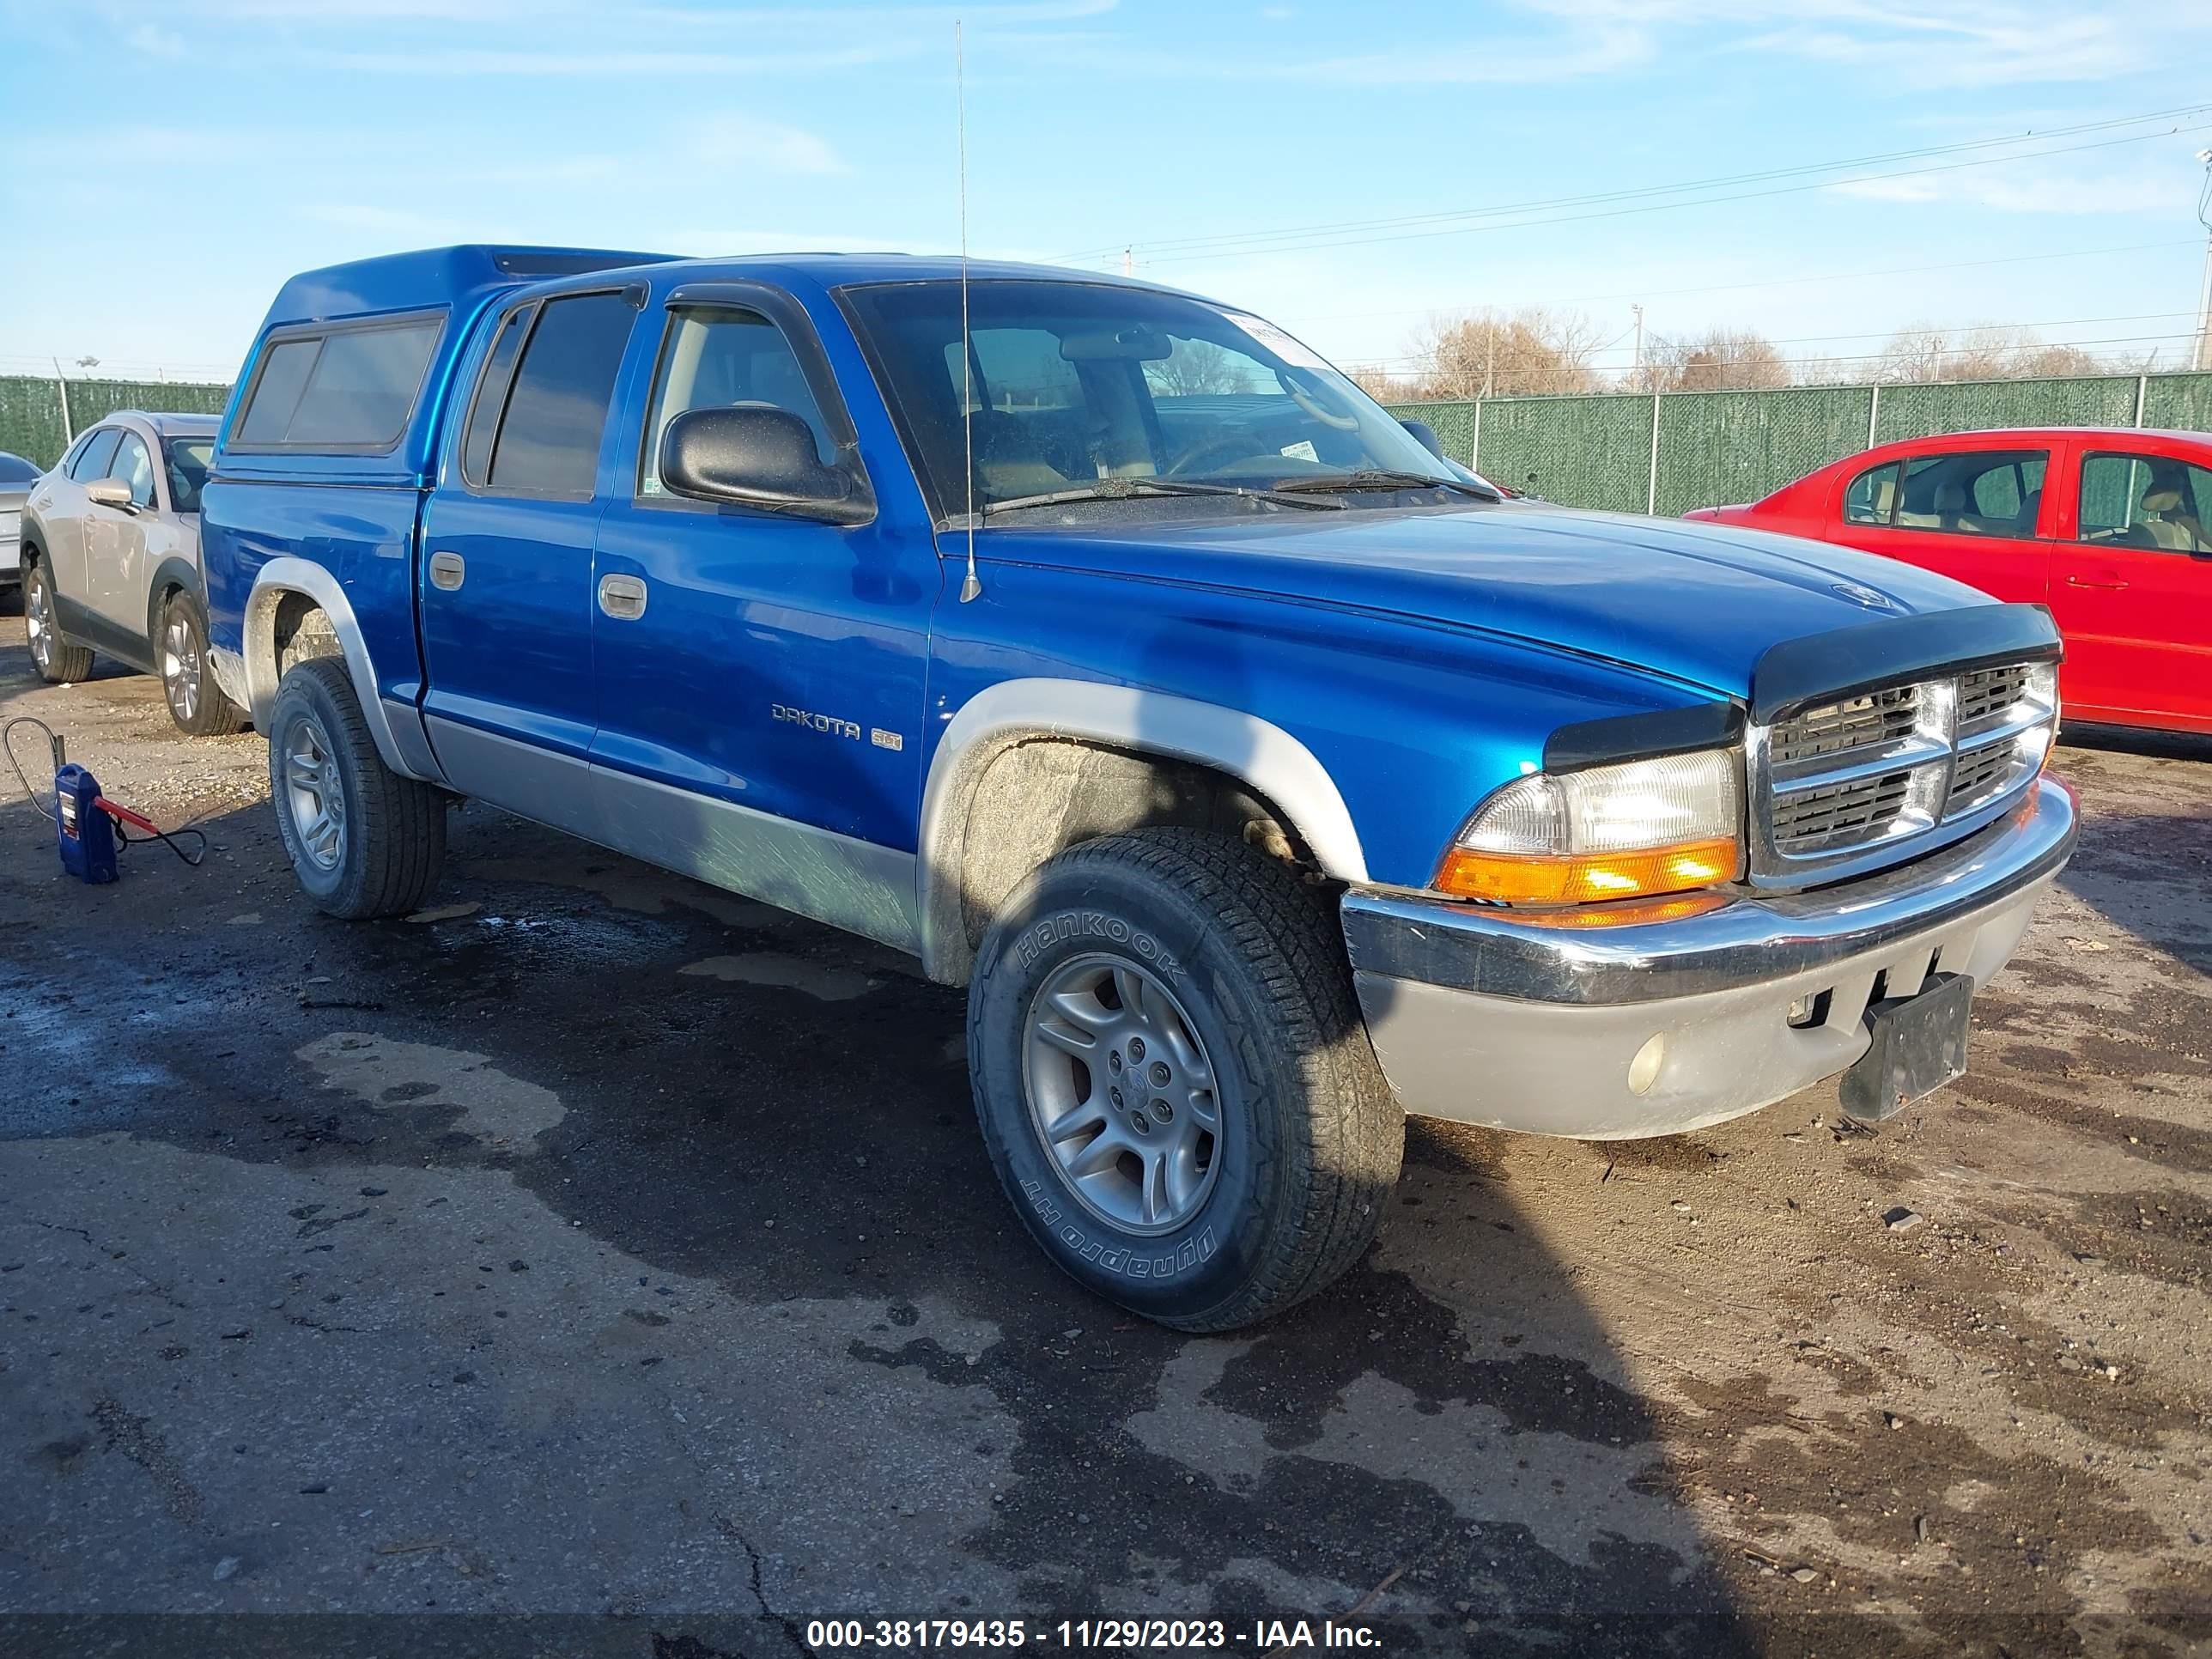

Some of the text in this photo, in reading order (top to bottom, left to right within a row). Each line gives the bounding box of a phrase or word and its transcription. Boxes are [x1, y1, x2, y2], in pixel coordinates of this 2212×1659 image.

[772, 703, 860, 740] DAKOTA
[1019, 1180, 1217, 1278] Dynapro HT
